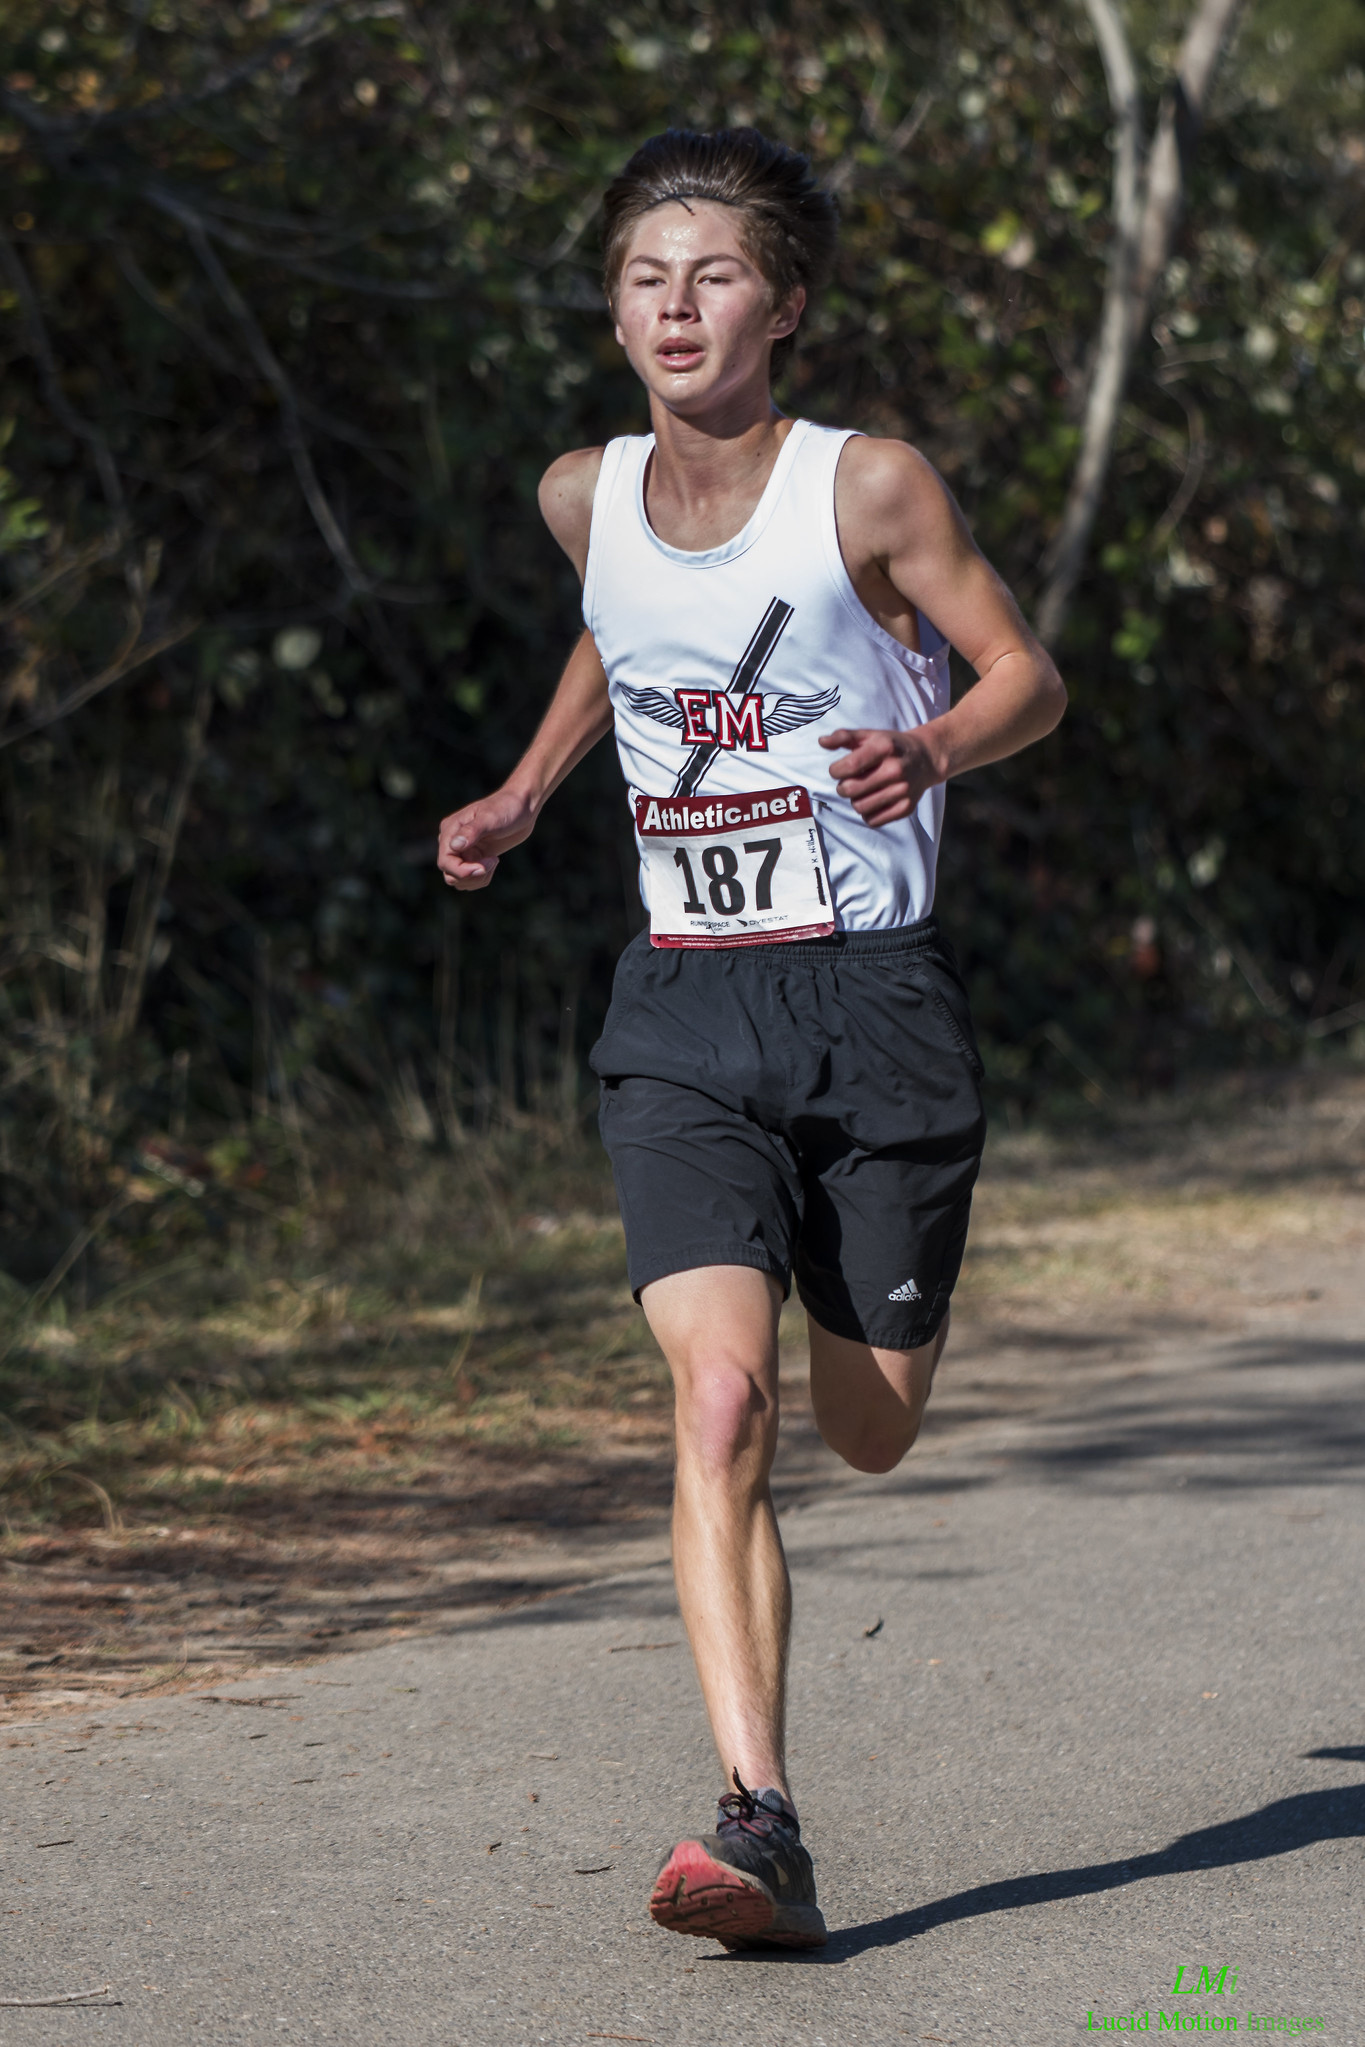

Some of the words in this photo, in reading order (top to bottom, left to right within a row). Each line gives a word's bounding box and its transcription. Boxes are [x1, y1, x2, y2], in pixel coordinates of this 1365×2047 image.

[675, 688, 769, 753] EM
[642, 790, 801, 831] Athletic.net
[673, 837, 783, 916] 187
